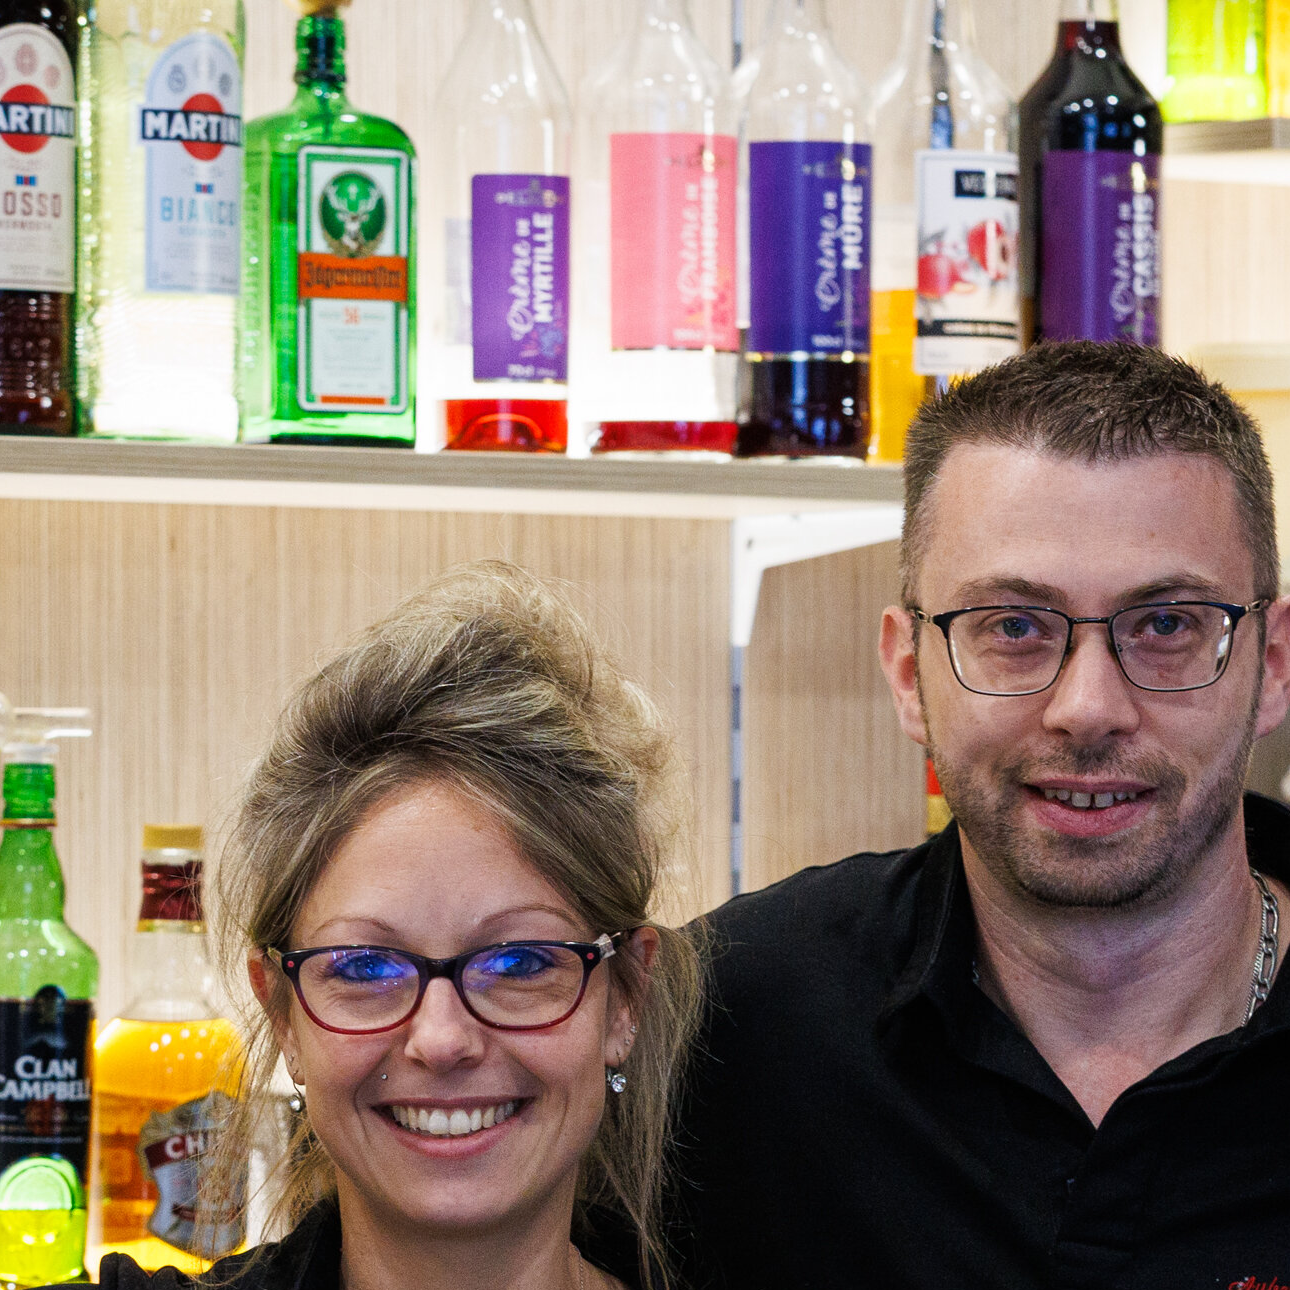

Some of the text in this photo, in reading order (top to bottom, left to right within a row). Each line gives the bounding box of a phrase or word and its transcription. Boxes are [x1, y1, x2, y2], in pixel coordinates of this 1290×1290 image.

[144, 111, 240, 144] MARTIN
[532, 212, 554, 323] MYRTILLE
[14, 1054, 77, 1079] CLAN
